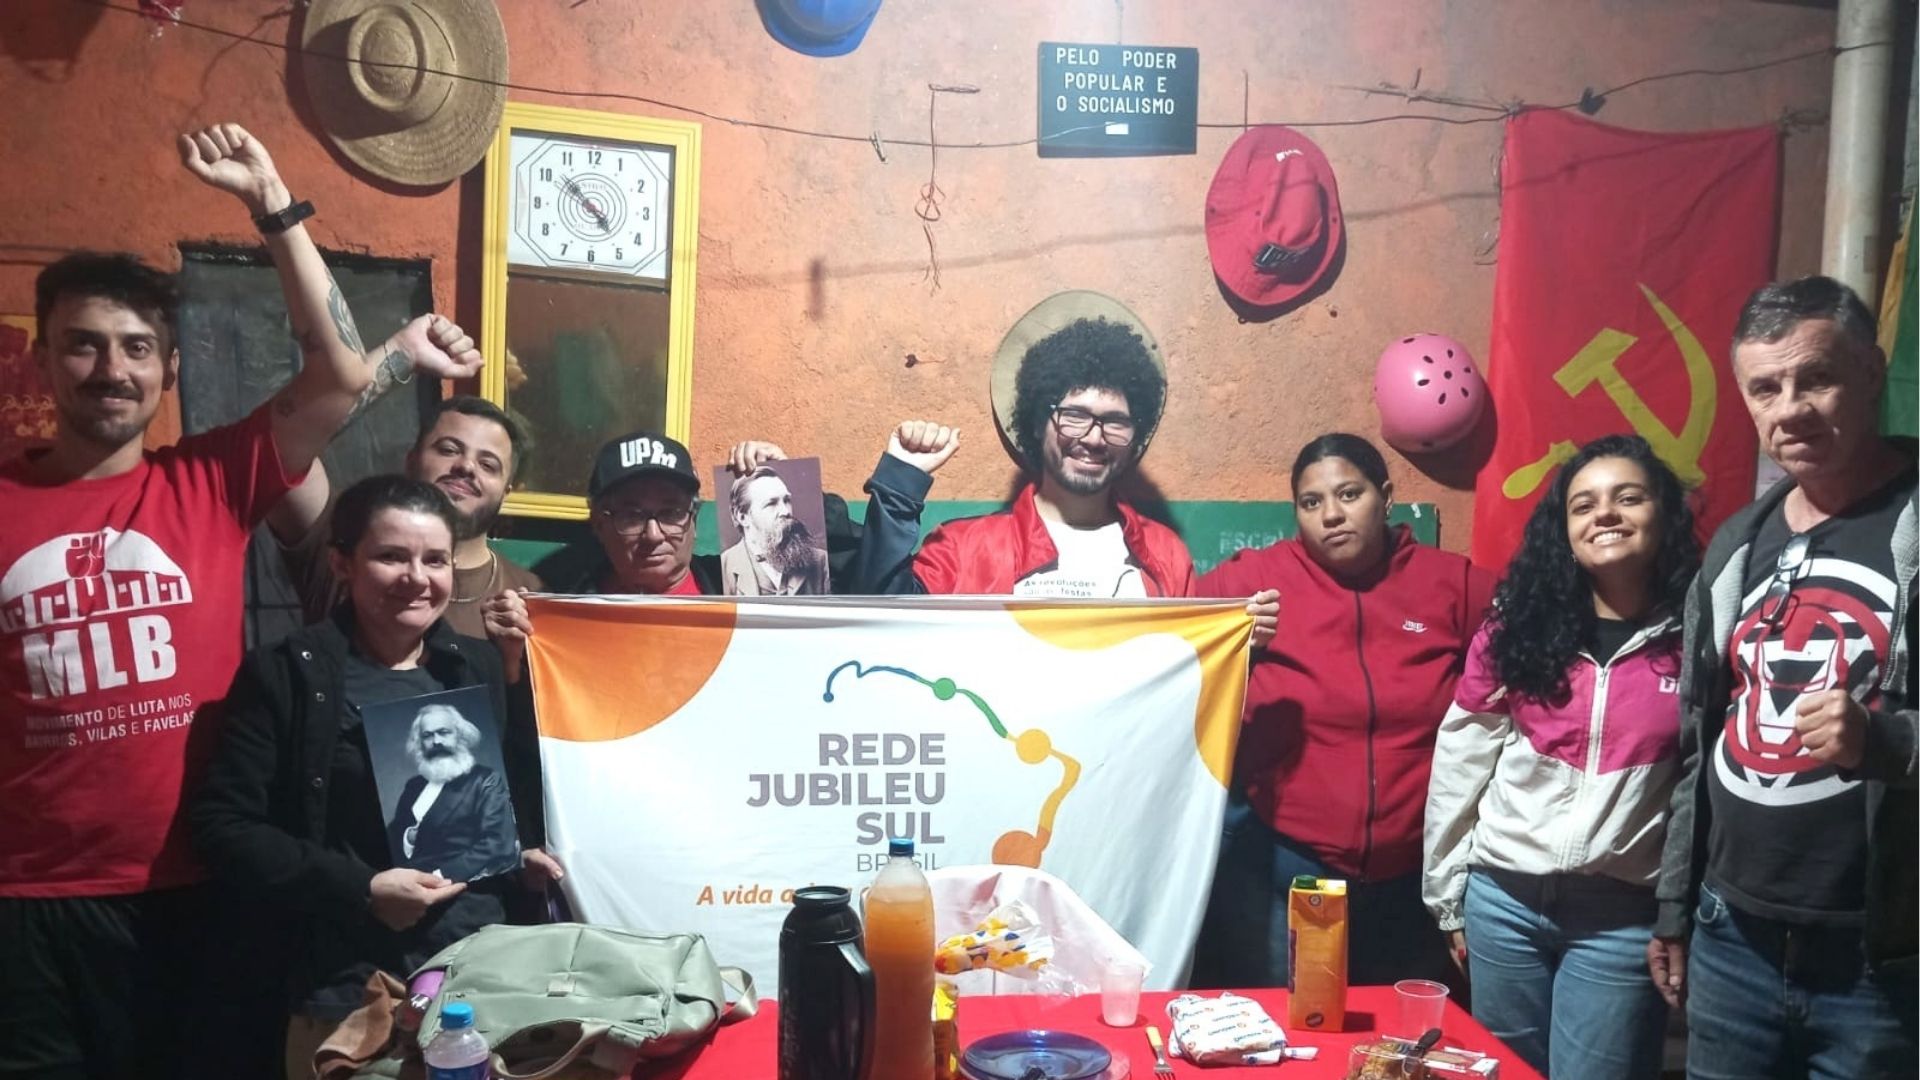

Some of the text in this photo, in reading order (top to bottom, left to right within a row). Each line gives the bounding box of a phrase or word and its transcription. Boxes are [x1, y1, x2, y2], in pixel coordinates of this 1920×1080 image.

[1056, 47, 1177, 69] PELO PODER
[1064, 72, 1167, 93] POPULAR E
[1056, 96, 1175, 115] O SOCIALISMO
[562, 151, 573, 166] 11
[588, 150, 602, 165] 12
[618, 158, 623, 172] 1
[540, 168, 552, 182] 10
[637, 179, 645, 193] 2
[533, 197, 541, 209] 9
[642, 207, 650, 221] 3
[542, 223, 550, 236] 8
[633, 232, 642, 246] 4
[560, 243, 568, 256] 7
[587, 250, 595, 262] 6
[615, 248, 623, 260] 5
[22, 614, 177, 700] MLB
[107, 706, 125, 720] DE
[130, 699, 166, 716] LUTA
[169, 693, 192, 709] NOS
[87, 724, 127, 742] VILAS
[132, 721, 139, 735] E
[144, 711, 195, 733] FAVELAS
[819, 733, 946, 766] REDE
[746, 772, 945, 807] JUBILEU
[856, 811, 945, 845] SUL
[696, 885, 714, 906] A
[722, 884, 772, 905] vida
